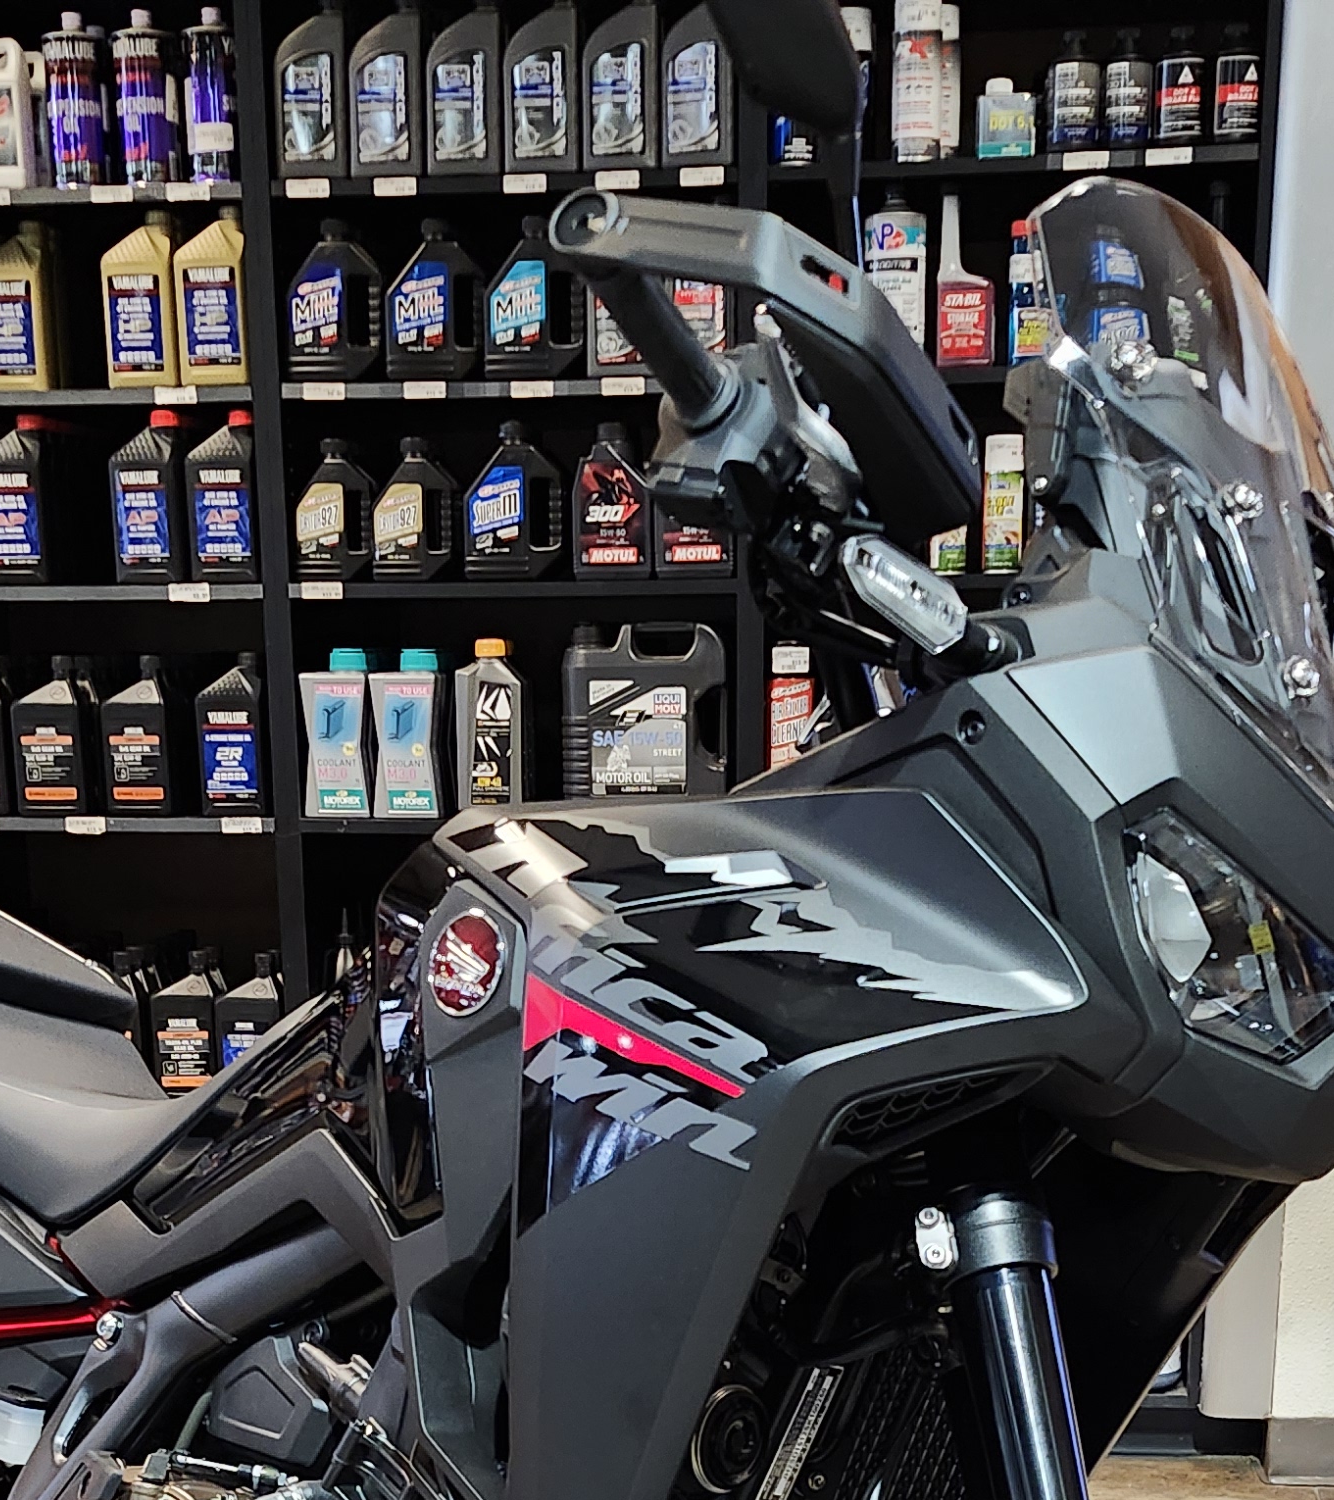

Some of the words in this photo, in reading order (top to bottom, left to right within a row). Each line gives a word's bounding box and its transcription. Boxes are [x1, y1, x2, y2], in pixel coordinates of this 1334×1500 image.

[320, 505, 339, 528] 927
[399, 505, 417, 528] 927
[585, 504, 641, 523] 300V
[590, 549, 638, 563] MOTUL
[673, 547, 720, 562] MOTUL
[332, 686, 343, 694] TO
[343, 686, 358, 694] USE
[402, 686, 412, 694] TO
[412, 686, 427, 694] USE
[654, 694, 681, 704] LIQUI
[654, 704, 681, 714] MOLY
[207, 711, 249, 724] YAMALUBE
[592, 730, 625, 747] SAE
[628, 732, 683, 746] 15W-50
[215, 746, 243, 761] 2R
[653, 748, 683, 757] STREET
[317, 759, 357, 767] COOLANT
[386, 759, 426, 767] COOLANT
[317, 768, 349, 780] M3.0
[387, 768, 417, 780] M3.0
[595, 772, 632, 783] MOTOR
[633, 772, 651, 783] OIL
[323, 796, 361, 806] MOTOREX
[392, 796, 430, 807] MOTOREX
